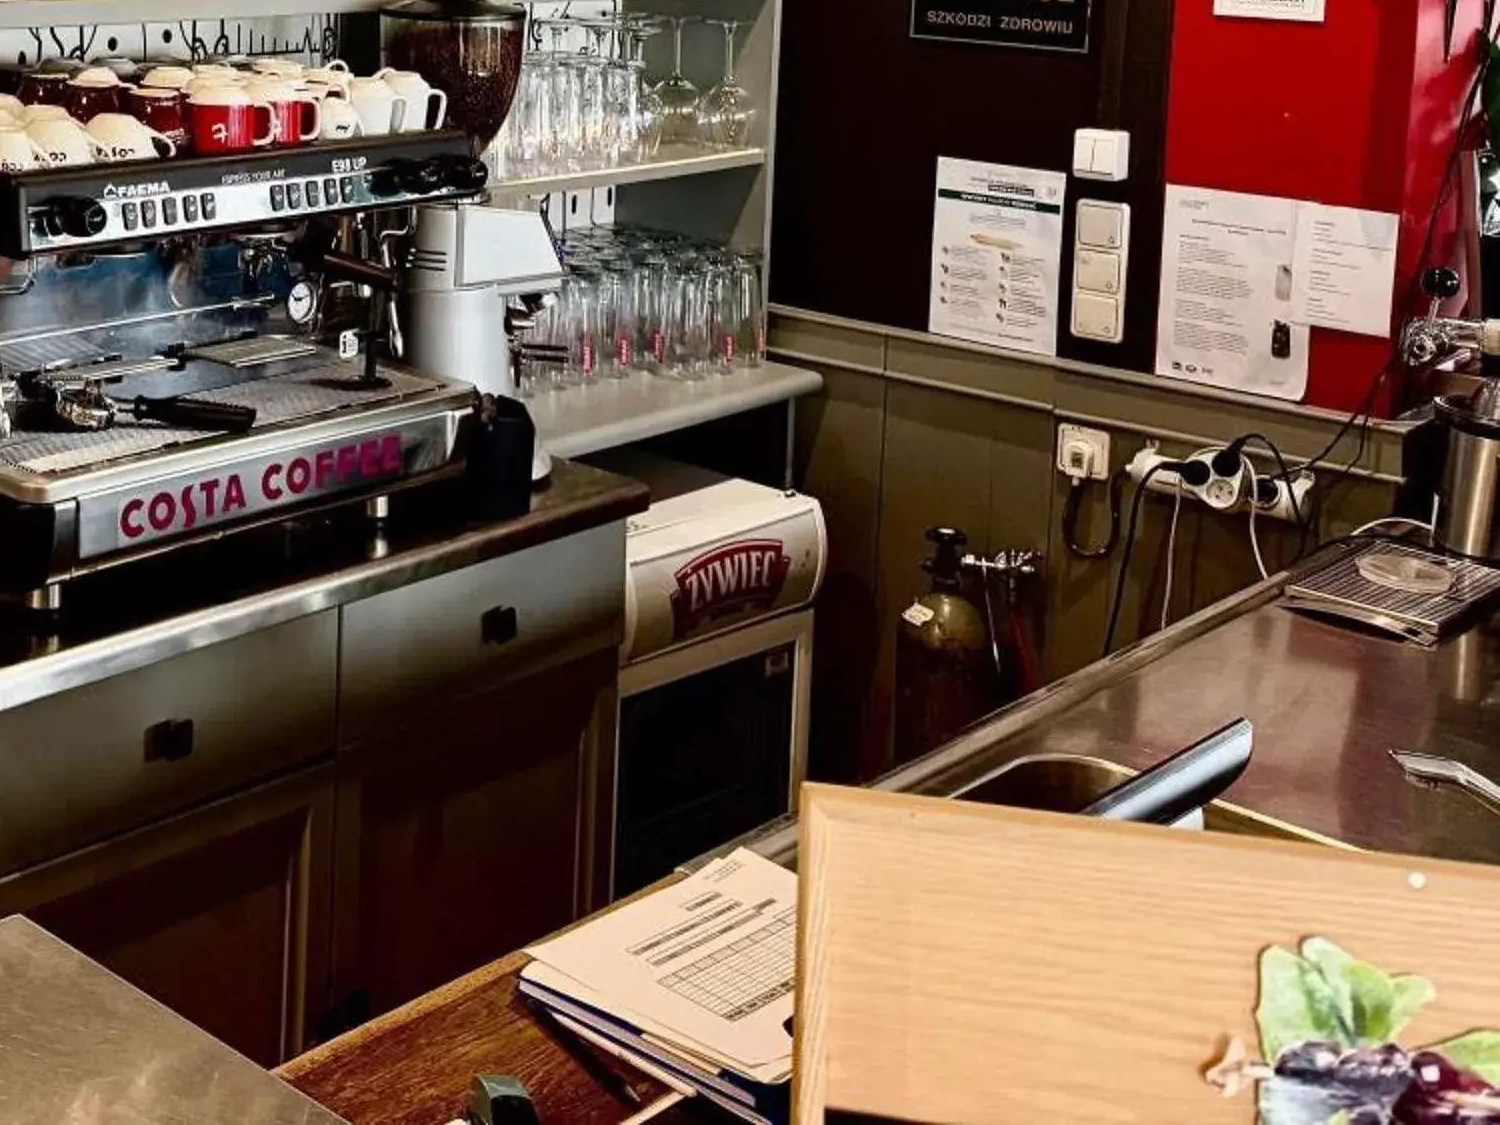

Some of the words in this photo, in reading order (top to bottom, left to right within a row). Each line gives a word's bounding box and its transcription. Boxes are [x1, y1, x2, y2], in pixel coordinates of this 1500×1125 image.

[927, 10, 991, 28] SZKODZI
[999, 16, 1074, 34] ZDROWIU
[117, 180, 171, 199] FAEMA
[119, 474, 246, 538] COSTA
[261, 434, 404, 501] COFFEE
